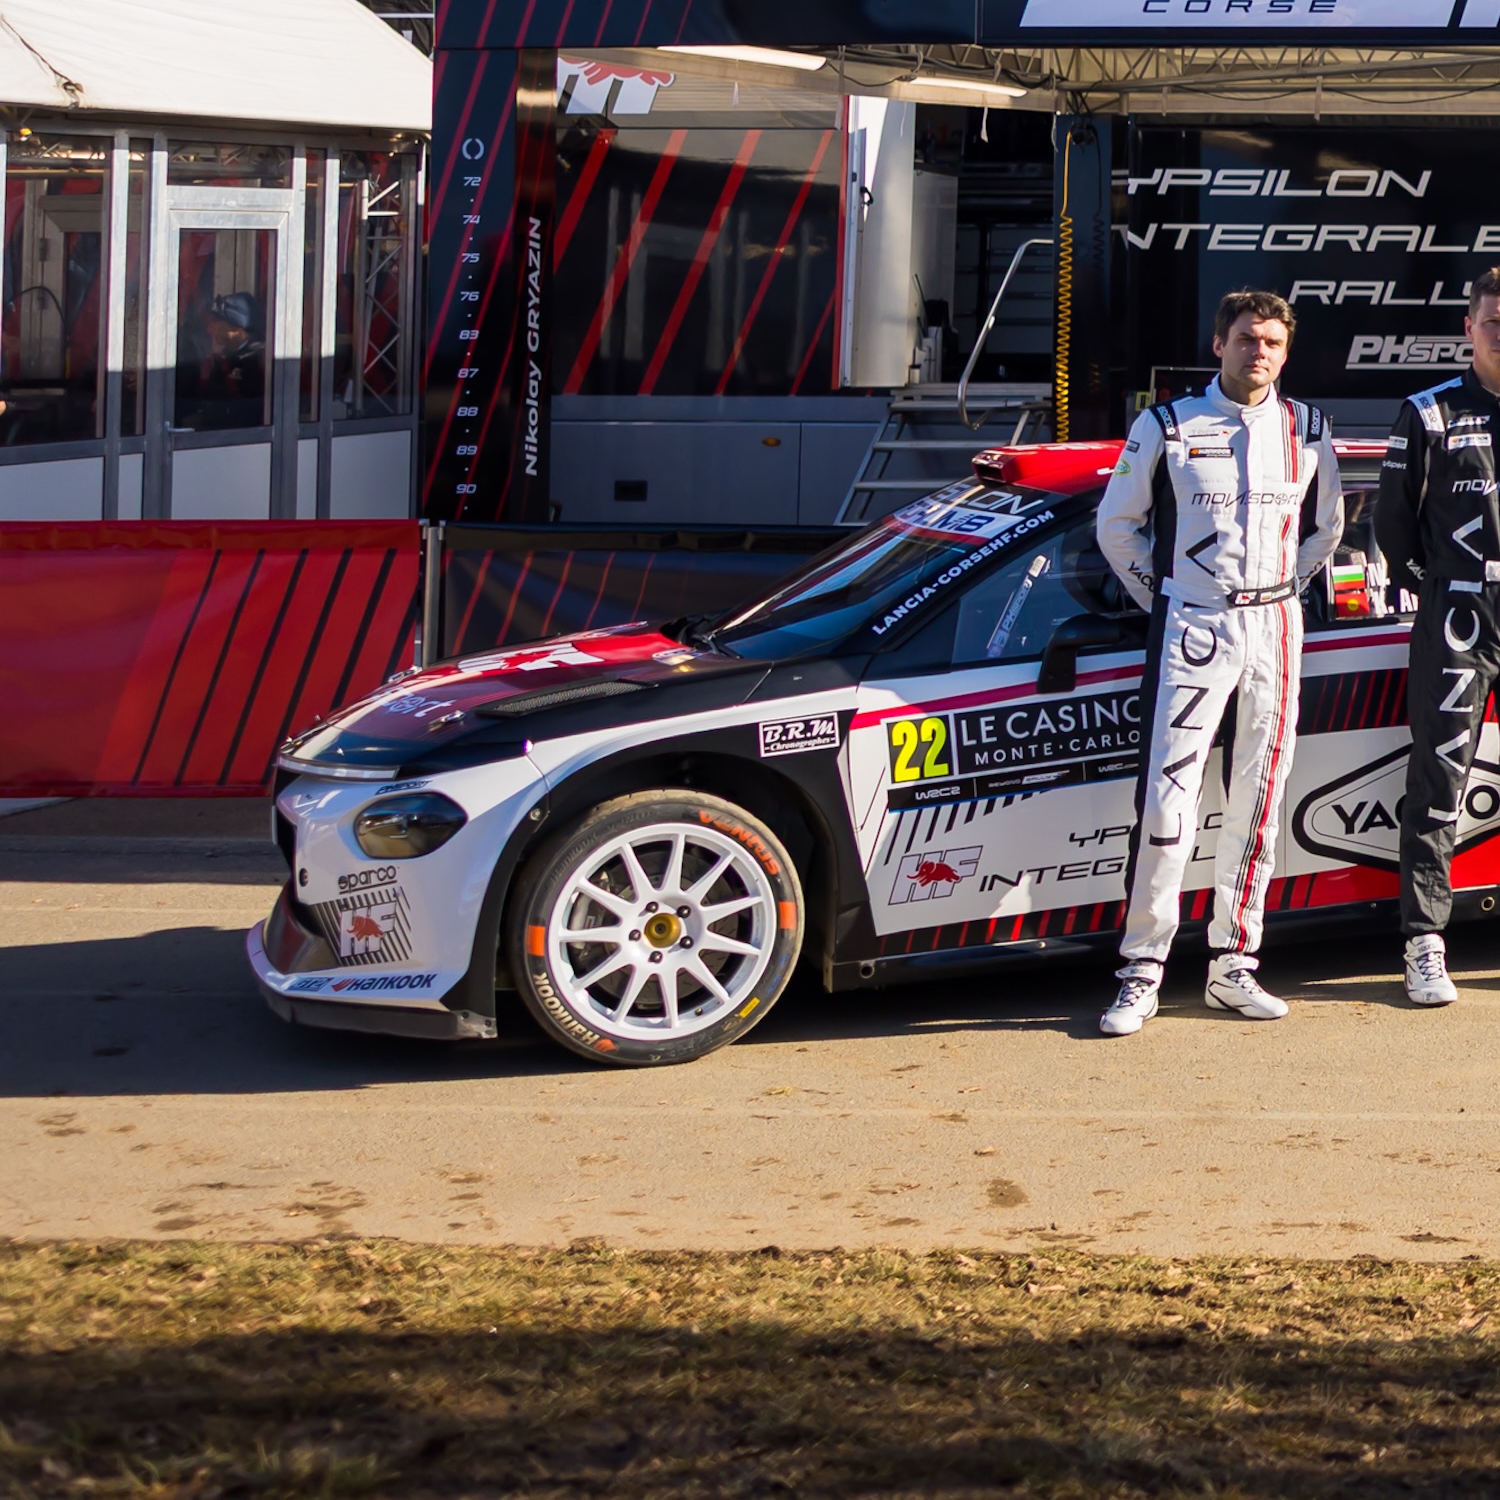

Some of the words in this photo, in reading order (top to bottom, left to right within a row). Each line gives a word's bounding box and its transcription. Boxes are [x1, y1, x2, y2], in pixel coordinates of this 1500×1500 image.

[463, 177, 481, 186] 72
[462, 215, 480, 224] 74
[461, 253, 480, 263] 75
[527, 217, 541, 352] GRYAZIN
[460, 291, 479, 301] 76
[459, 330, 479, 340] 83
[1345, 334, 1472, 370] PHSPO
[458, 368, 479, 378] 87
[457, 407, 478, 417] 88
[525, 360, 542, 476] Nikolay
[456, 445, 478, 455] 89
[456, 484, 477, 494] 90
[871, 509, 1055, 636] LANCIA-CORSEHF.COM
[961, 715, 999, 747] LE
[1006, 697, 1141, 739] CASINO
[891, 716, 951, 783] 22
[974, 743, 1050, 767] MONTE
[1069, 729, 1141, 752] CARLO
[915, 785, 961, 800] WRC2
[1331, 784, 1500, 835] YAO
[338, 865, 397, 891] sparco
